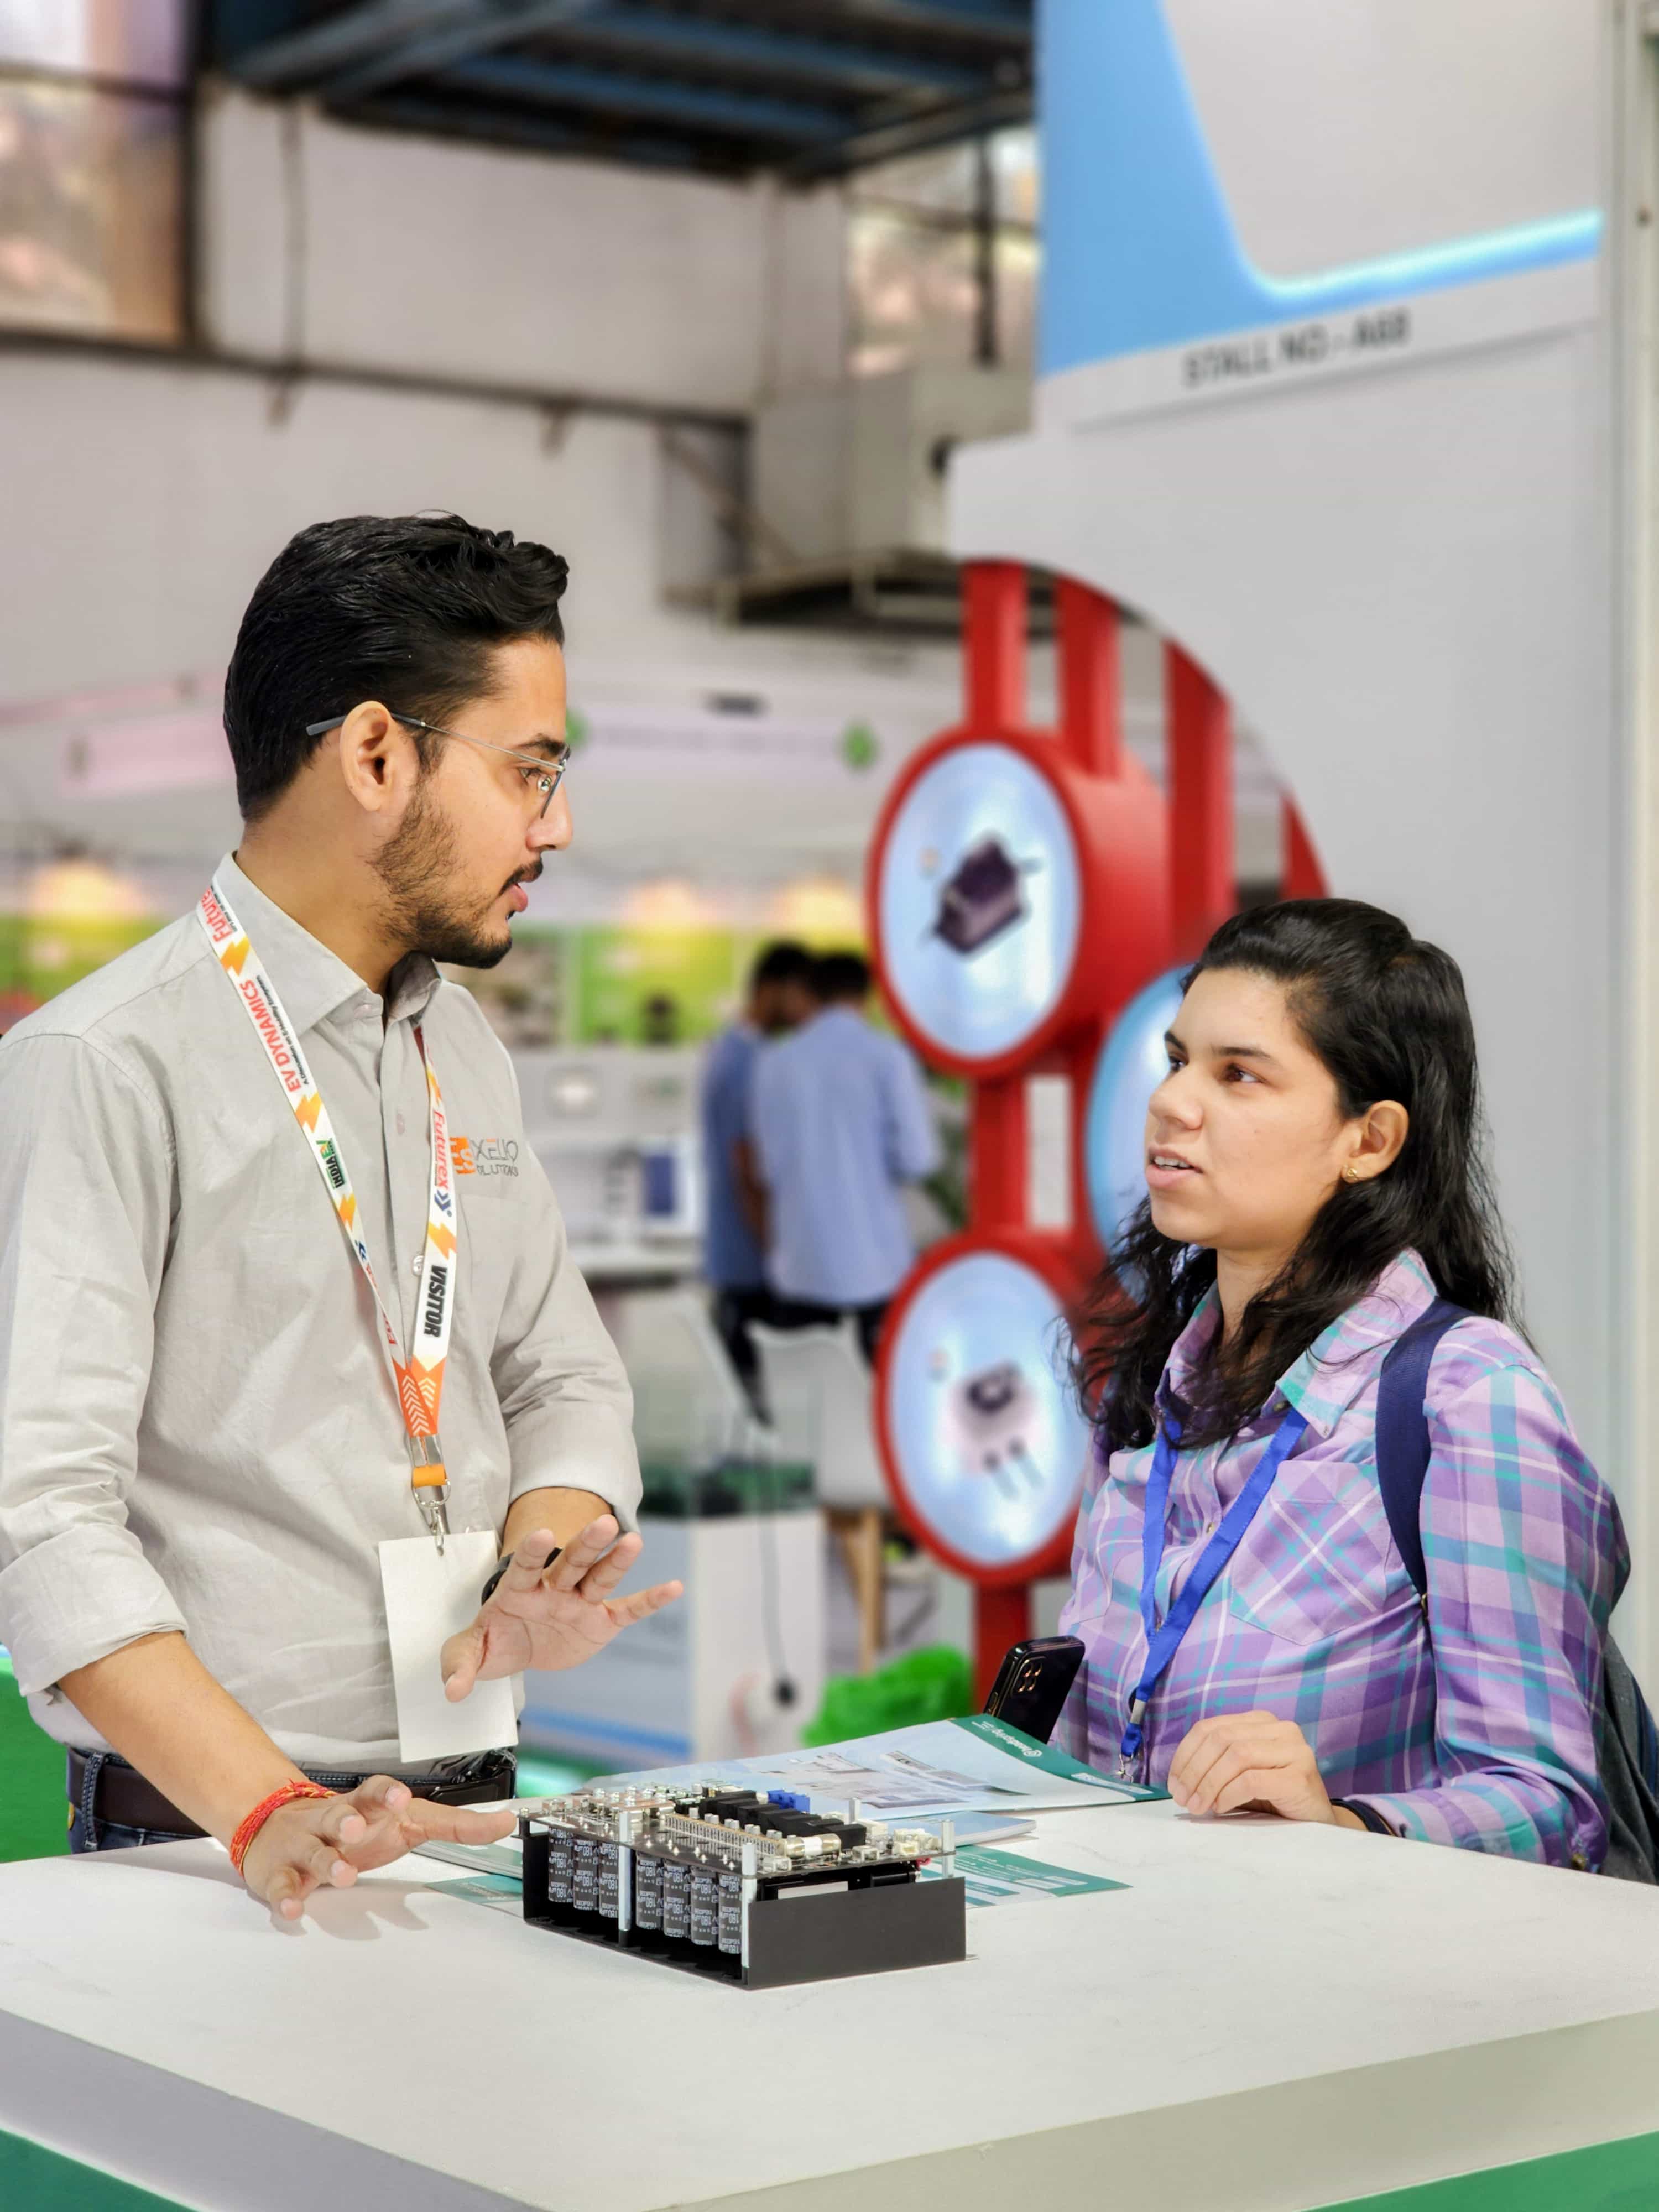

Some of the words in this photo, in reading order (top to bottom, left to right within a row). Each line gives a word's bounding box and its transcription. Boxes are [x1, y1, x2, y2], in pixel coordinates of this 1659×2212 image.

[239, 979, 291, 1067] DYNAMICS
[281, 1070, 302, 1092] EV
[434, 1110, 448, 1190] Futurex
[424, 1265, 448, 1338] VISITOR
